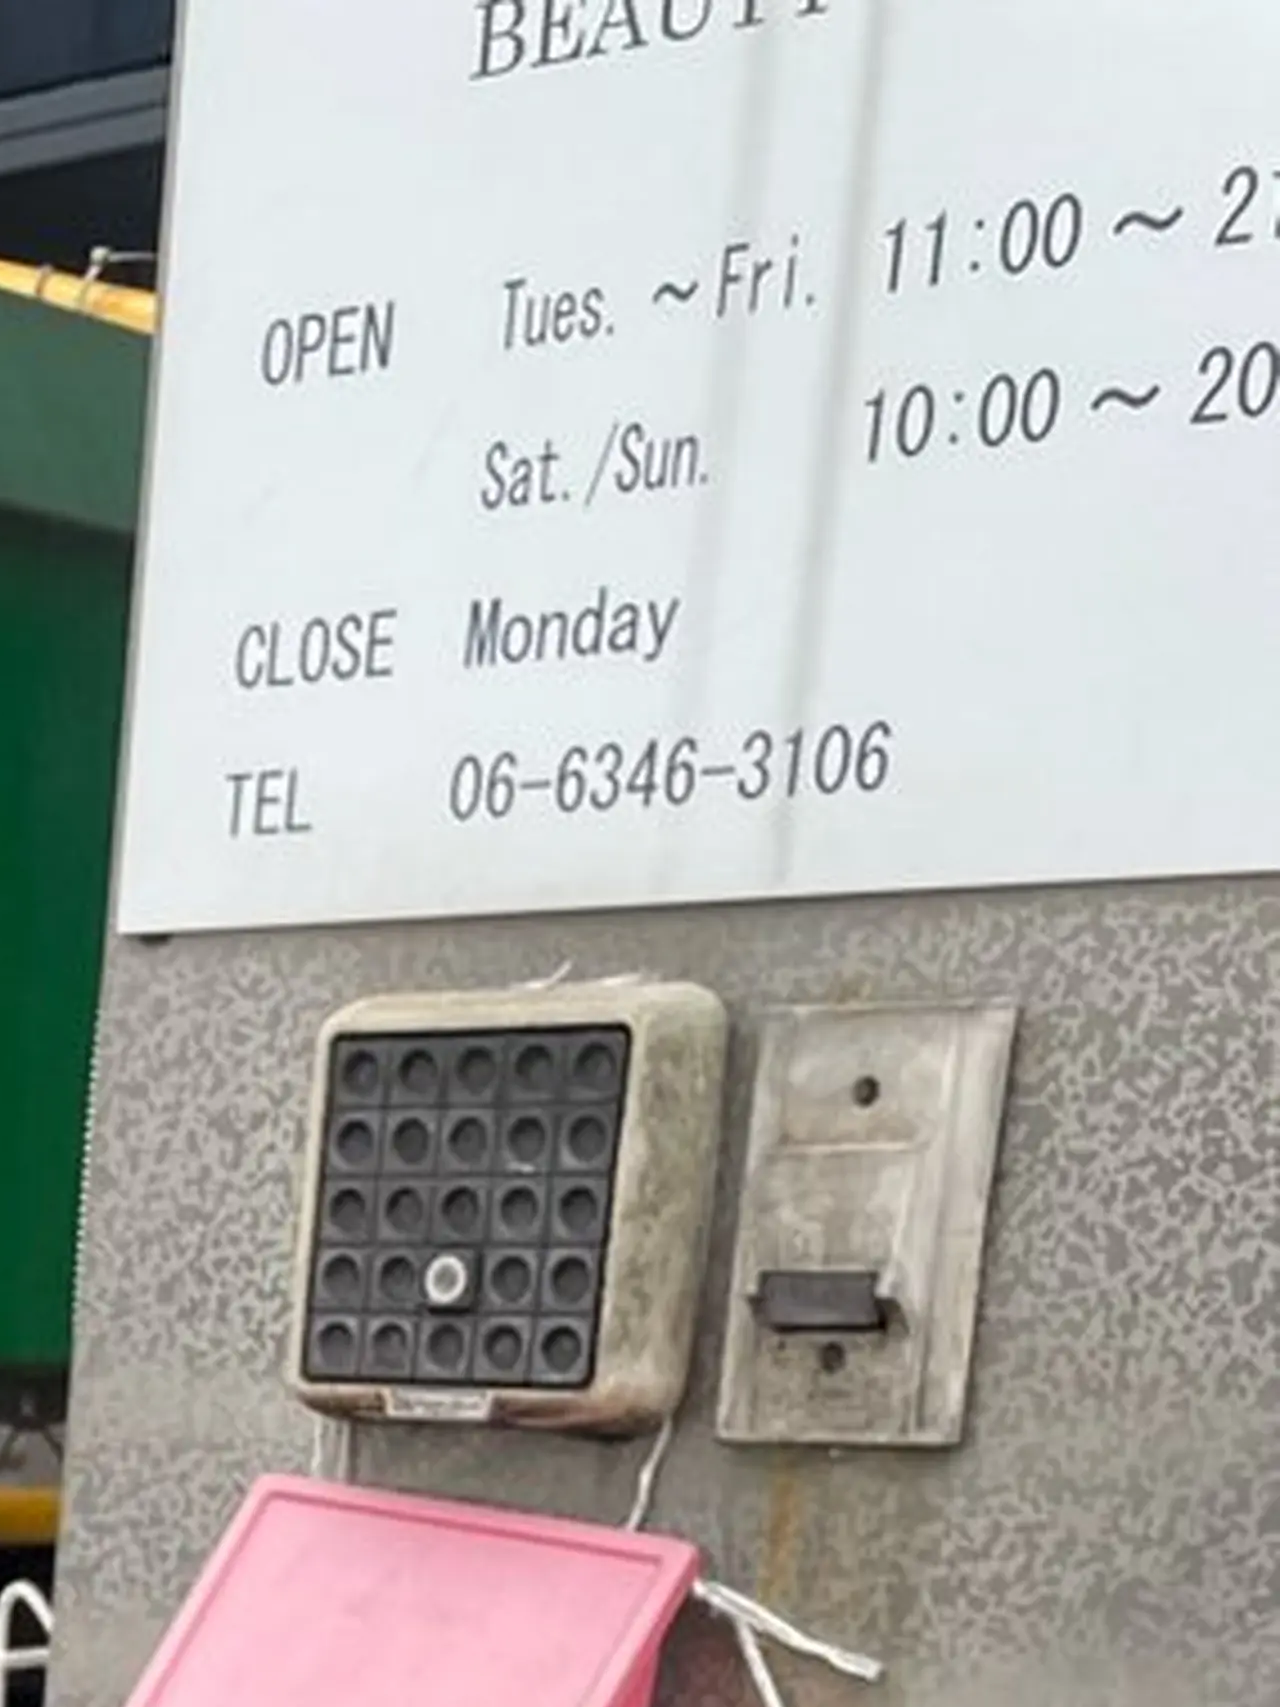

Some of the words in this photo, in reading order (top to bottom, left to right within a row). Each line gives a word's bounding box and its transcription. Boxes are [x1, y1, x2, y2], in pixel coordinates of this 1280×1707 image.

[468, 0, 828, 82] BEAU
[260, 299, 396, 388] OPEN
[502, 276, 615, 352] Tues.
[884, 191, 1084, 295] 11:00
[1213, 164, 1280, 249] 2
[863, 366, 1062, 465] 10:00
[1188, 339, 1280, 426] 20
[234, 607, 399, 691] CLOSE
[462, 584, 682, 671] Monday
[225, 767, 314, 838] TEL
[448, 718, 893, 823] 06-6346-3106
